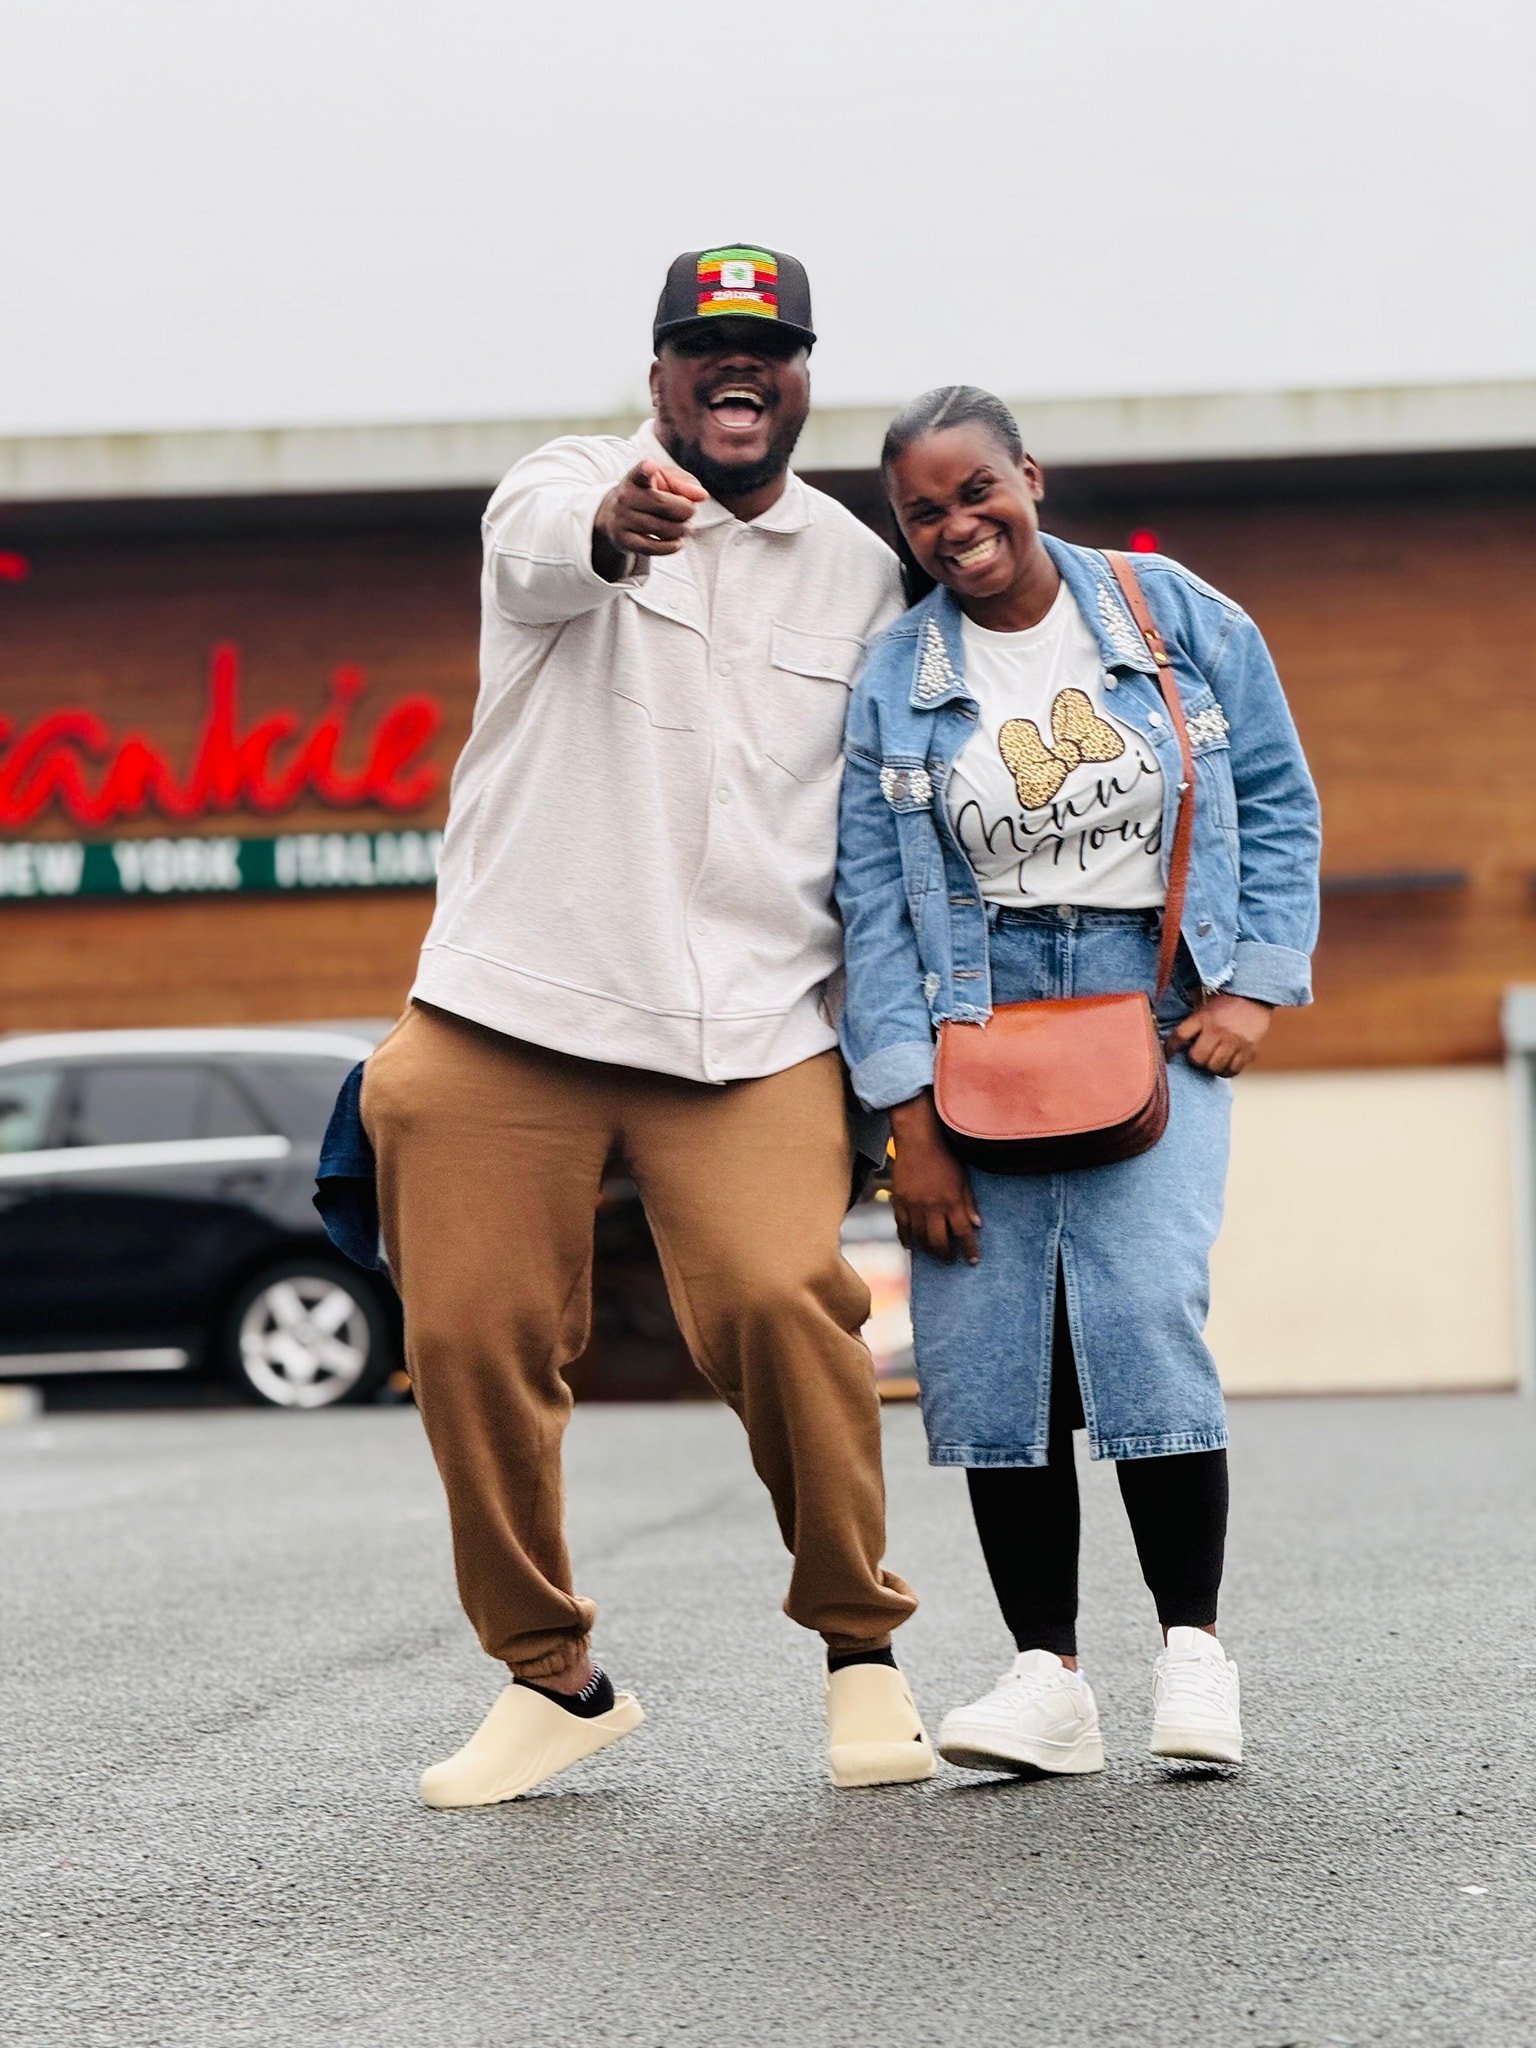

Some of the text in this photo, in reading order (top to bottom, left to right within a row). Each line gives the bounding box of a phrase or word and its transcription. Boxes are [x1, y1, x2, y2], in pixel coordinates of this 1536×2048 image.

[0, 641, 440, 826] ankie
[0, 842, 85, 895] EW
[112, 838, 242, 892] YORK
